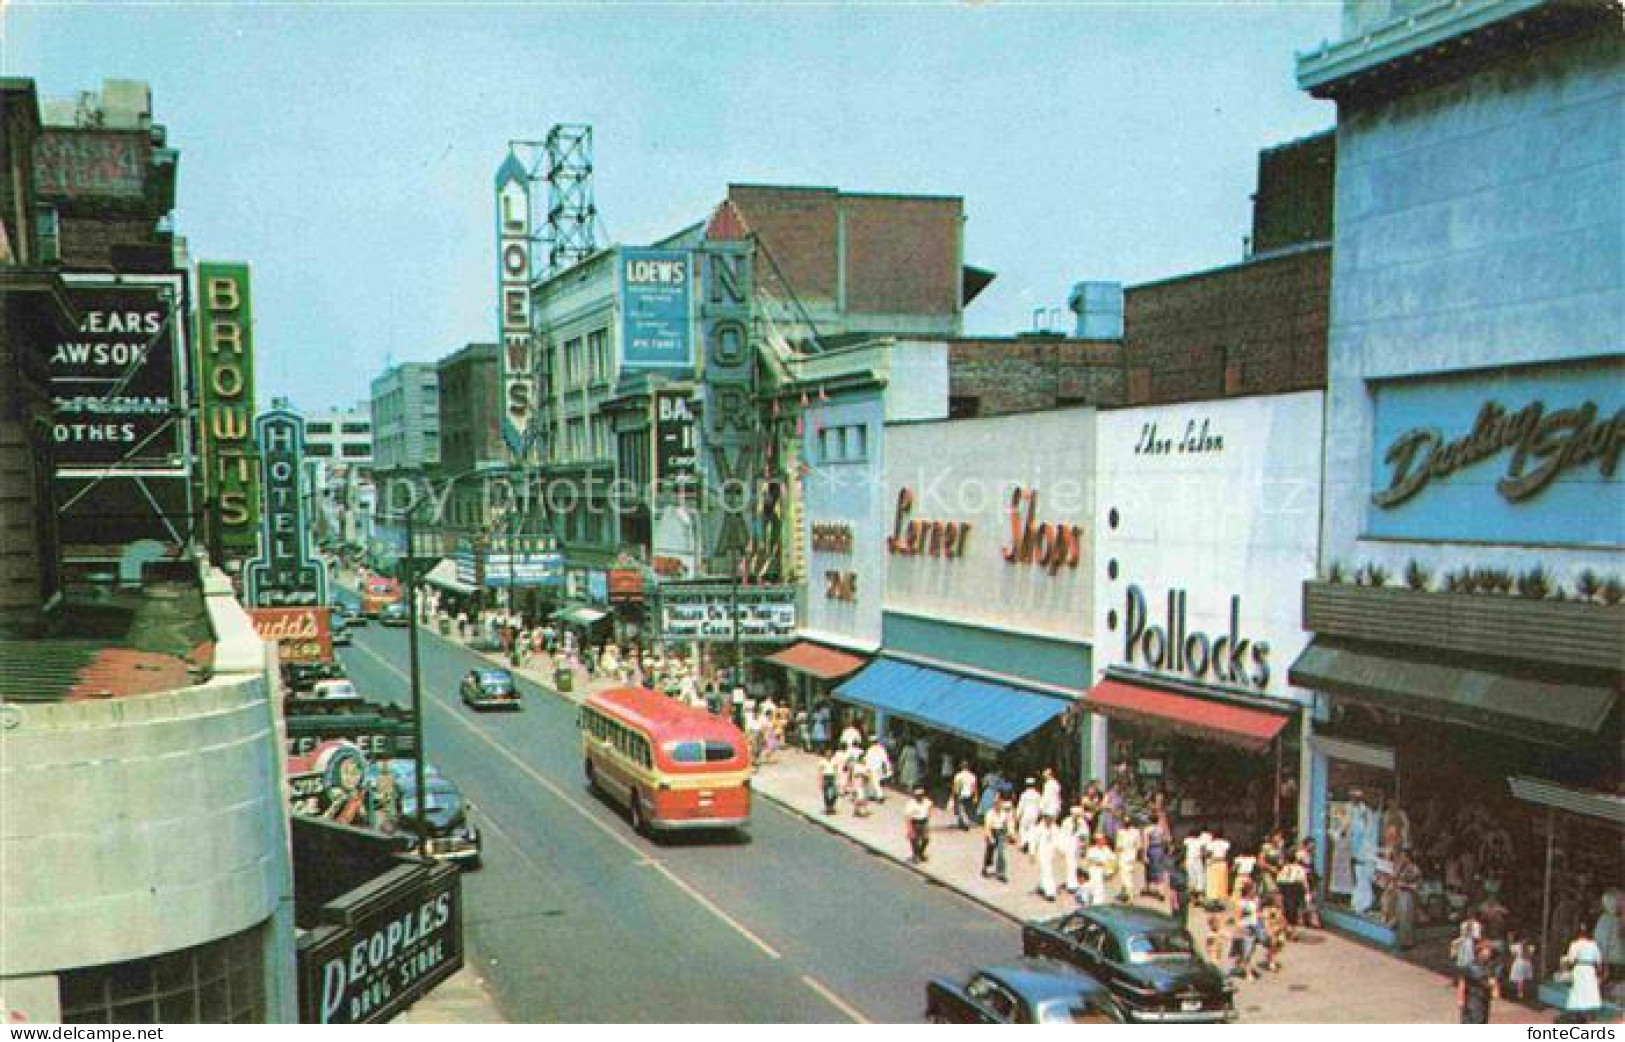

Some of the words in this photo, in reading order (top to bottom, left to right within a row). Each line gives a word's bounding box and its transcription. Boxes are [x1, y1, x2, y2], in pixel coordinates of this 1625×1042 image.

[626, 260, 687, 284] LOEWS
[80, 312, 161, 332] EARS
[269, 427, 294, 558] HOTEL
[886, 487, 972, 560] Lerner
[1001, 486, 1083, 578] Shops
[1124, 583, 1271, 688] Pollocks
[321, 892, 449, 1024] PEOPLES
